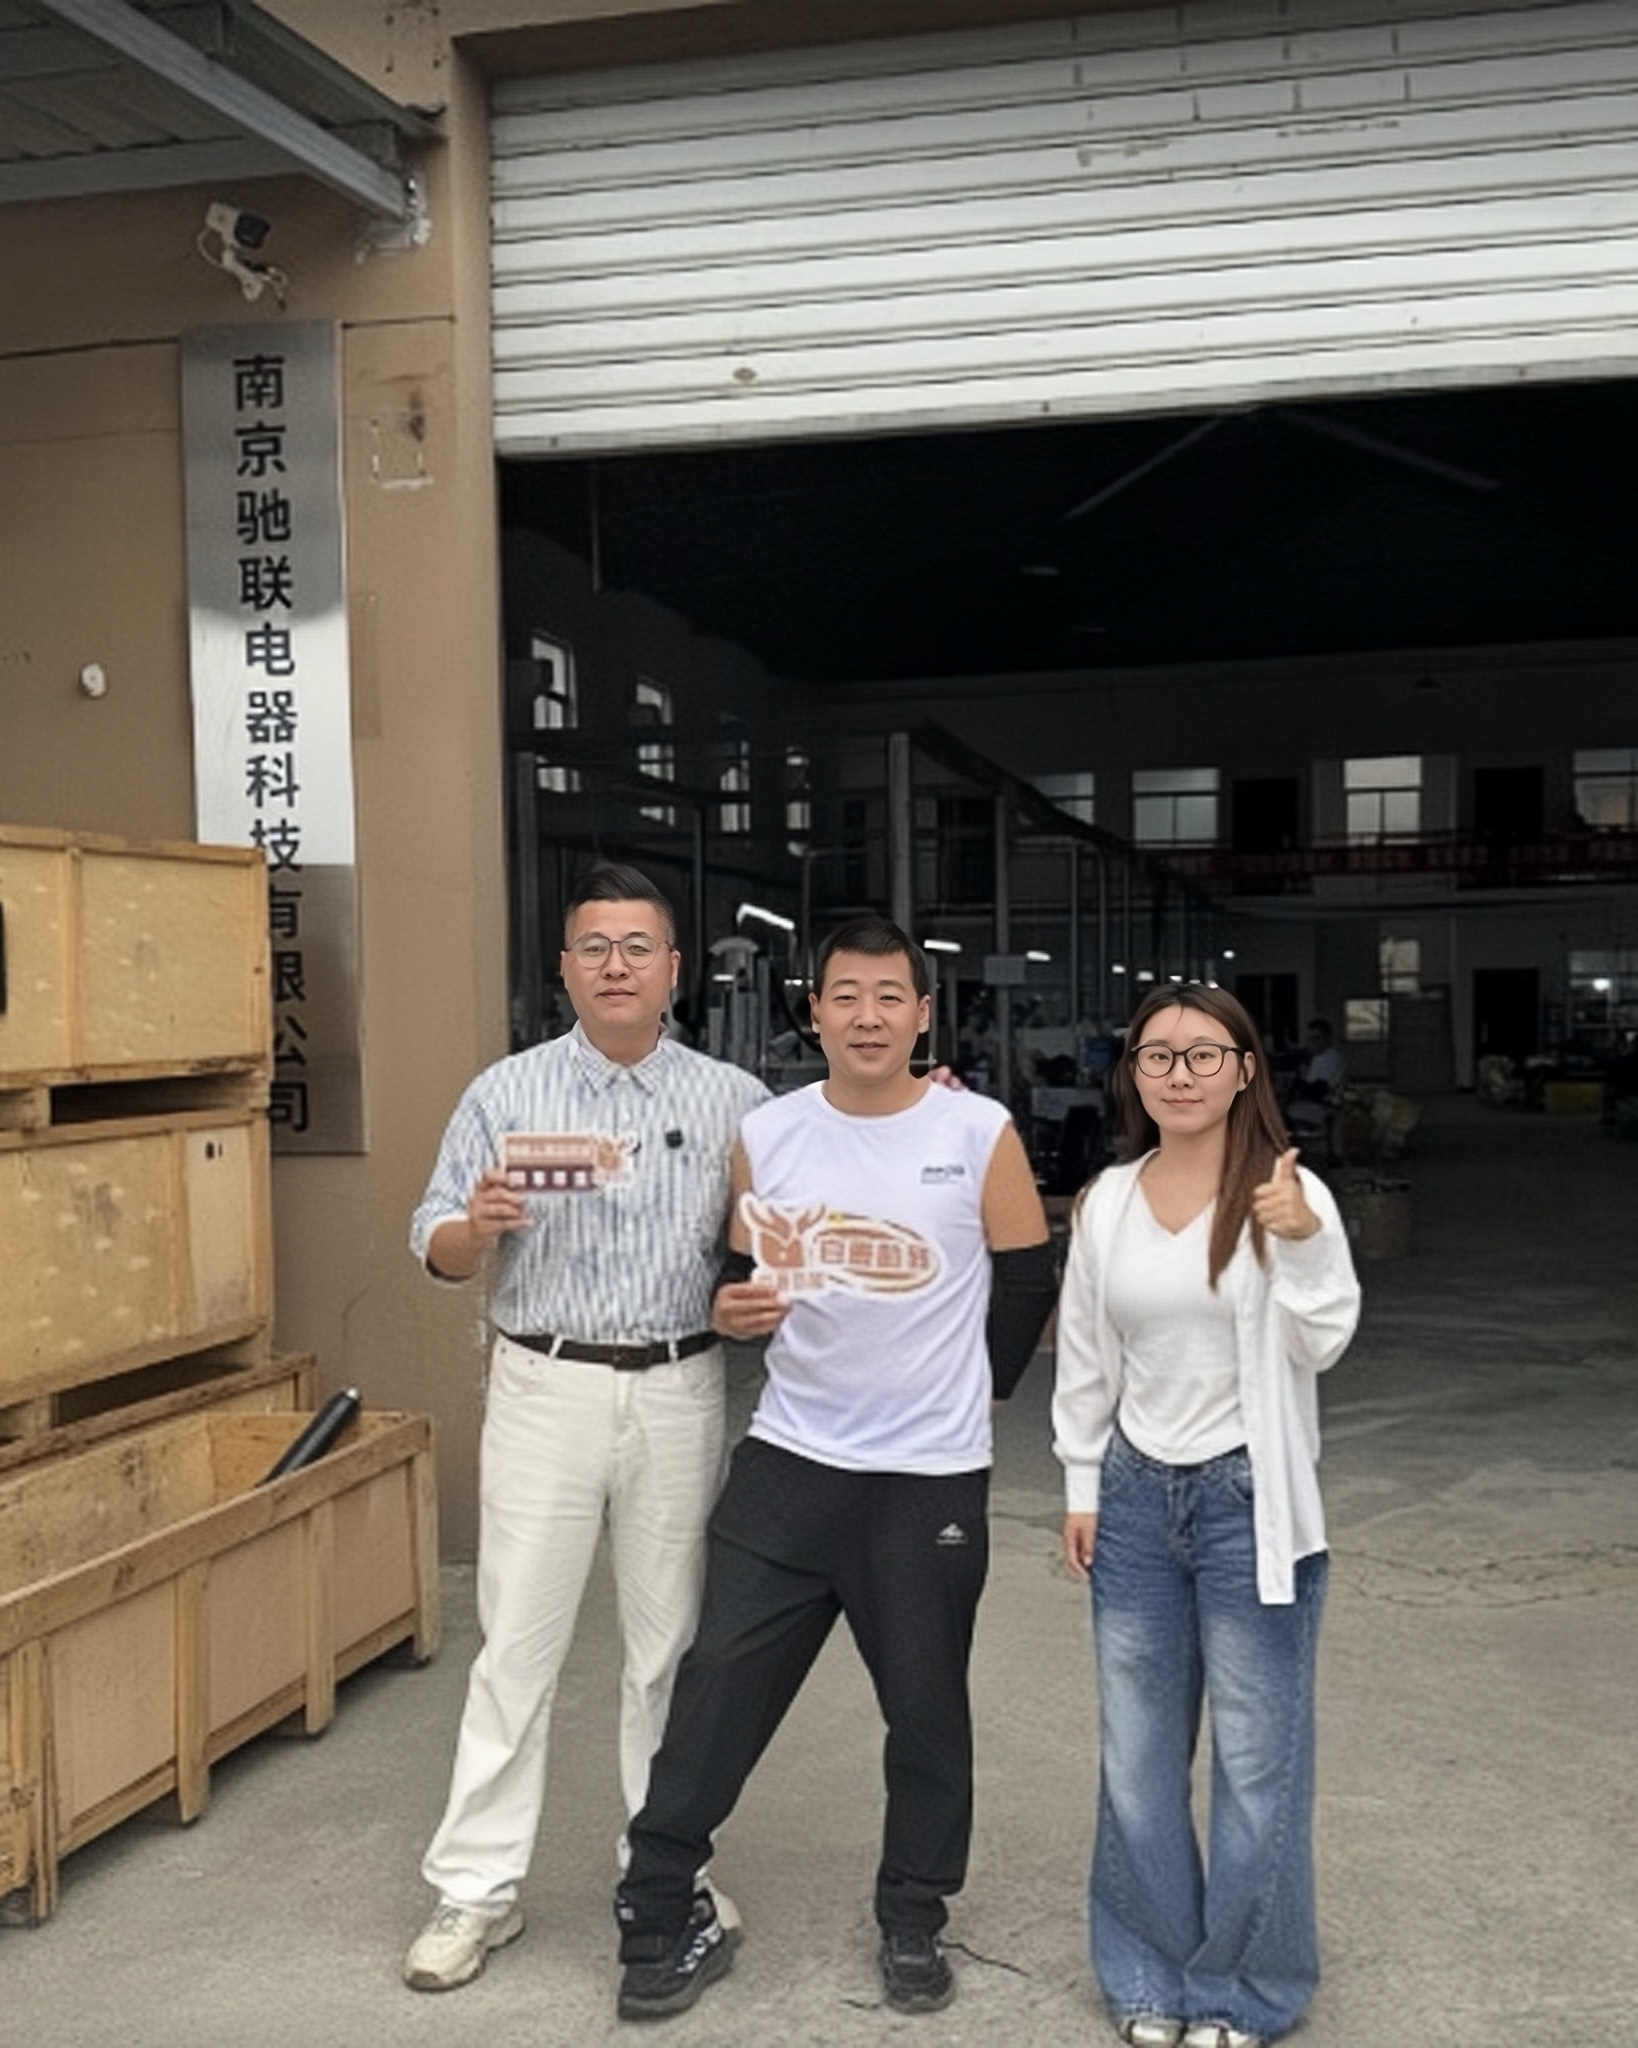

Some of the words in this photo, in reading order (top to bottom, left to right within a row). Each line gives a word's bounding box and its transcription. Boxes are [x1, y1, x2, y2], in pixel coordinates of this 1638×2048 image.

[232, 354, 309, 1132] 南京驰联电器科技有限公司
